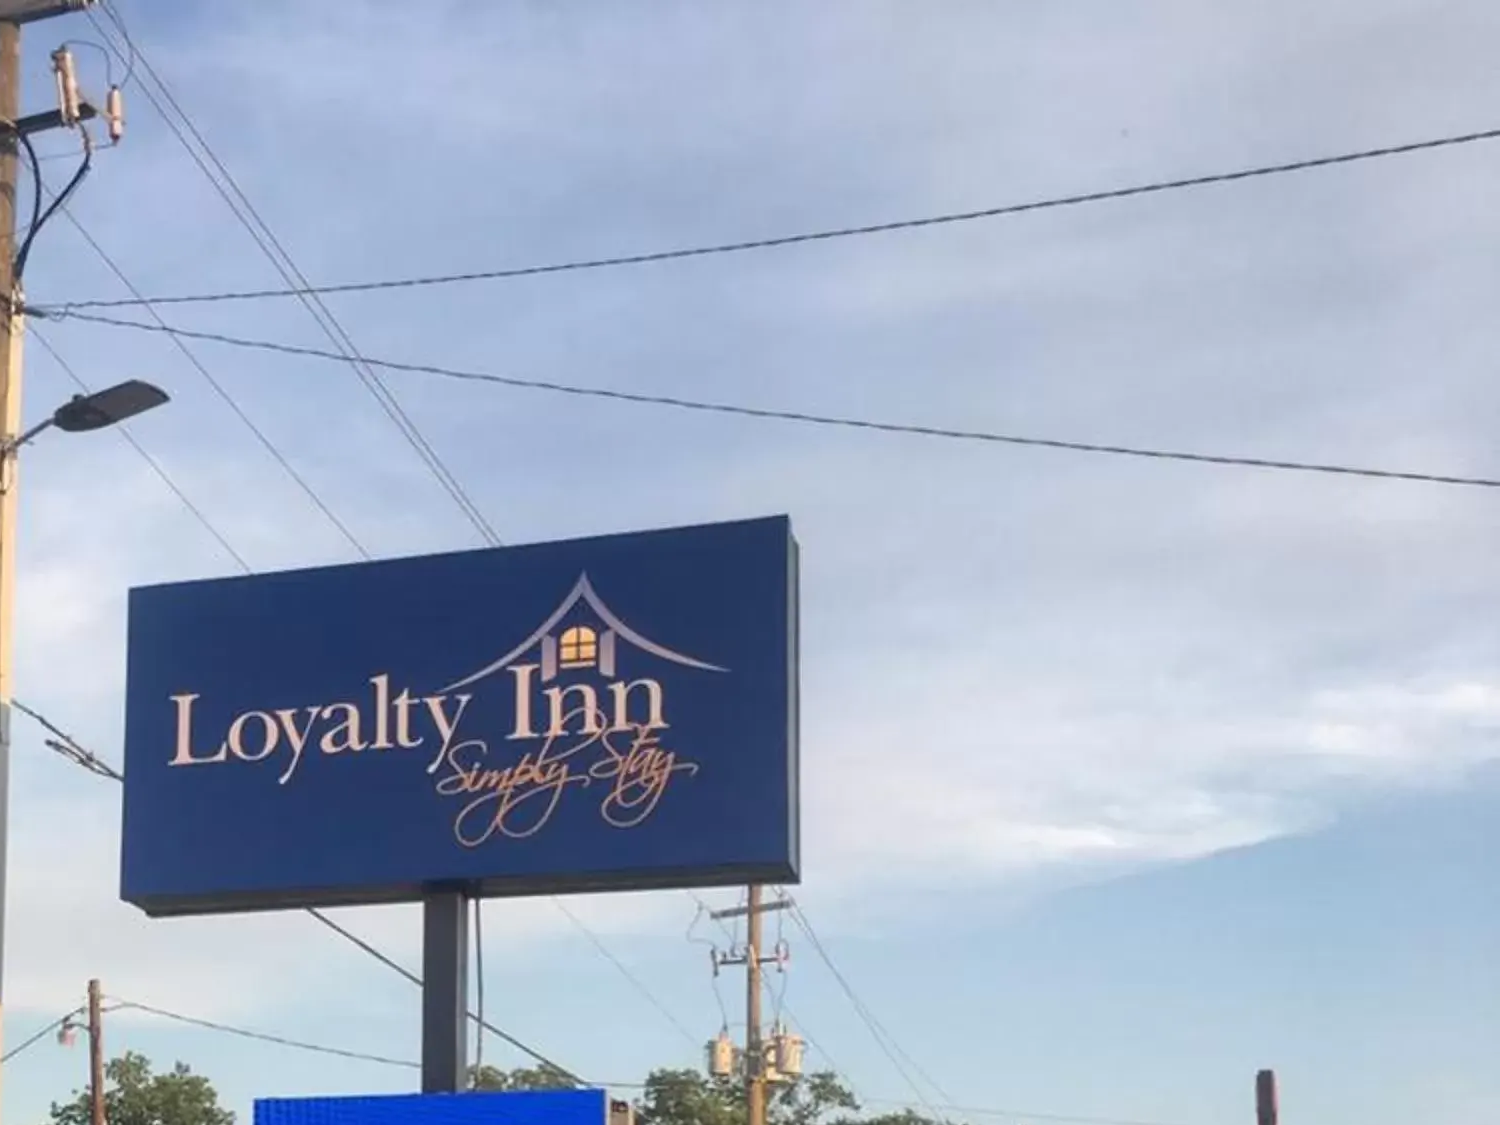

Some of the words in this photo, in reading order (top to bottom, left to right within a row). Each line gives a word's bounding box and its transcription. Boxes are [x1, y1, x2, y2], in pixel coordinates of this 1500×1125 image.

[168, 673, 472, 784] Loyalty
[505, 664, 670, 739] Inn
[436, 706, 607, 846] Simply
[589, 723, 699, 827] Stay
